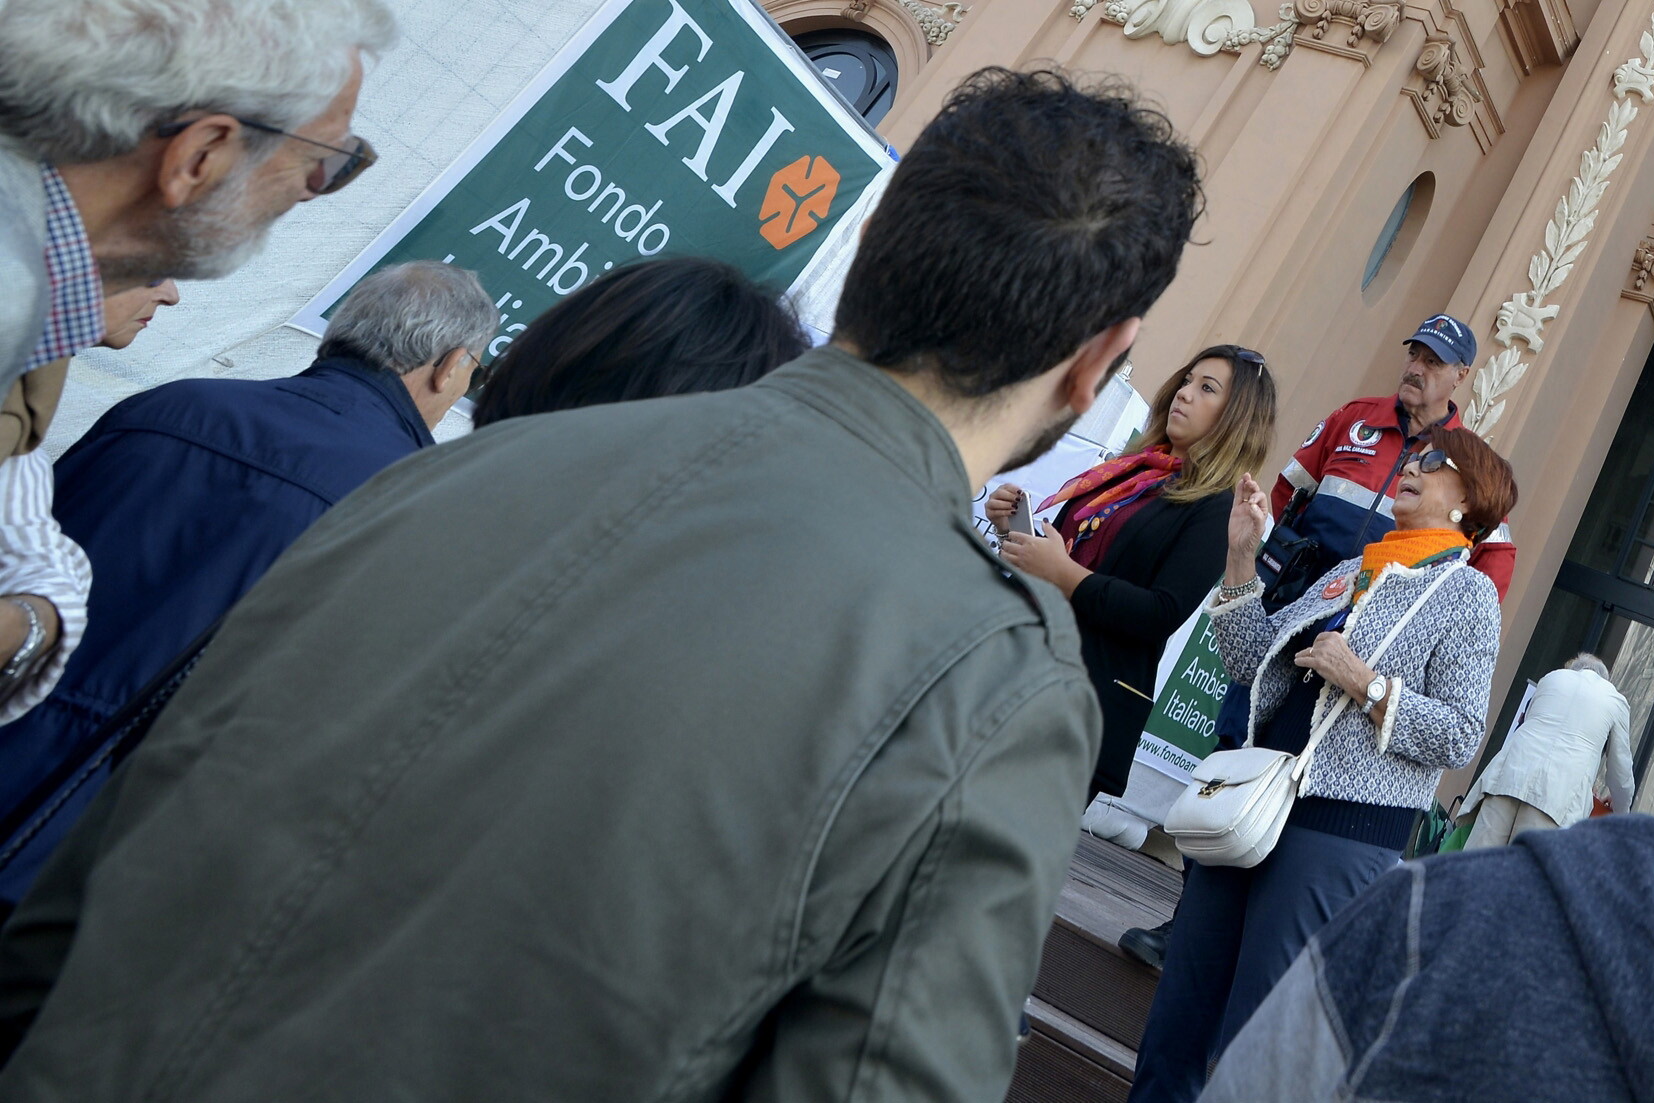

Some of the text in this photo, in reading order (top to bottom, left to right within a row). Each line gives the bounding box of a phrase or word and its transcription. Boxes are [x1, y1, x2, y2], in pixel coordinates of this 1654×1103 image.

[533, 125, 671, 257] Fondo
[1181, 656, 1228, 704] Ambie
[1163, 689, 1216, 738] Italiano
